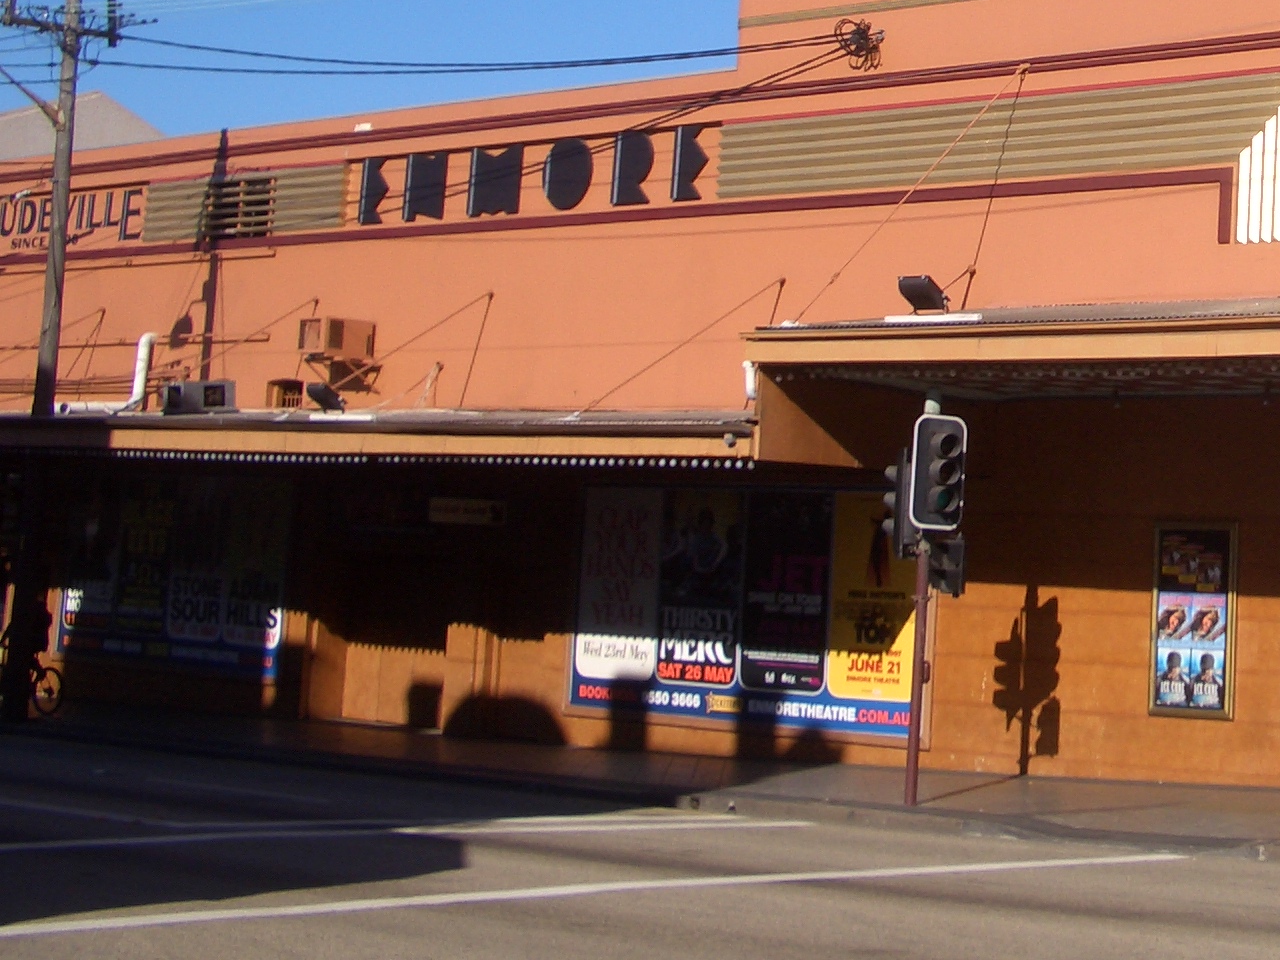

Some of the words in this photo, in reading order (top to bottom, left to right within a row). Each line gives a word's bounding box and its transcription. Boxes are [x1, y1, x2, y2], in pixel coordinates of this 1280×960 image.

[358, 124, 710, 226] ENMORE
[11, 235, 47, 249] SINCE
[171, 599, 220, 622] SOUR
[227, 603, 278, 628] HILLS
[662, 606, 737, 631] THIRSTY
[659, 629, 735, 665] MERC
[657, 662, 682, 680] SAT
[684, 664, 702, 681] 26
[703, 666, 734, 685] MAY
[848, 658, 883, 674] JUNE
[887, 660, 901, 675] 21
